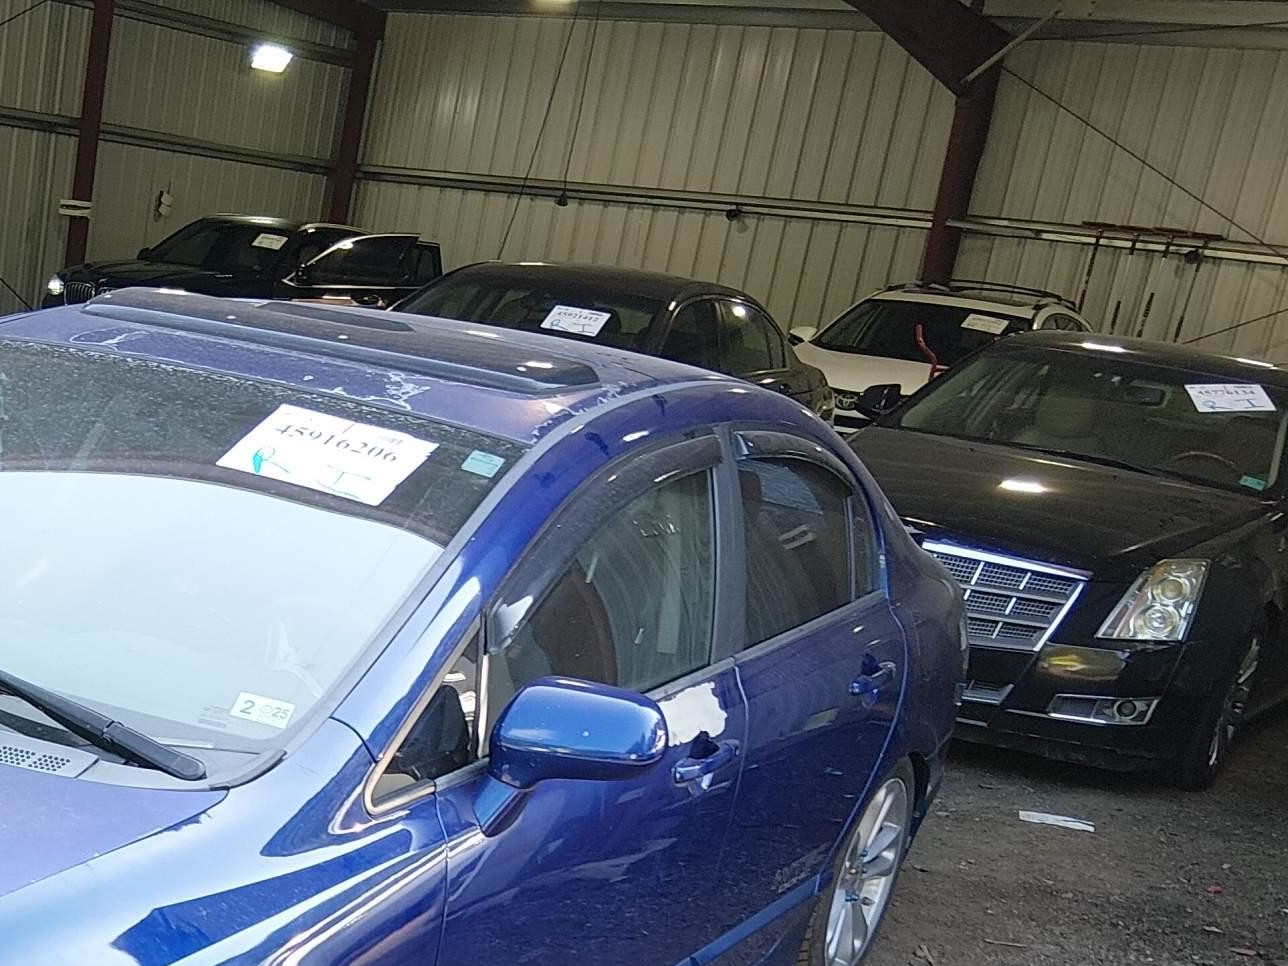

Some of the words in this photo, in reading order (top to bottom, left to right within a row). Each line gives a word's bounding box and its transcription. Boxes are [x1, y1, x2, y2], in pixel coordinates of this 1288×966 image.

[273, 423, 399, 463] 45916206
[239, 699, 256, 715] 2
[271, 706, 291, 720] 25
